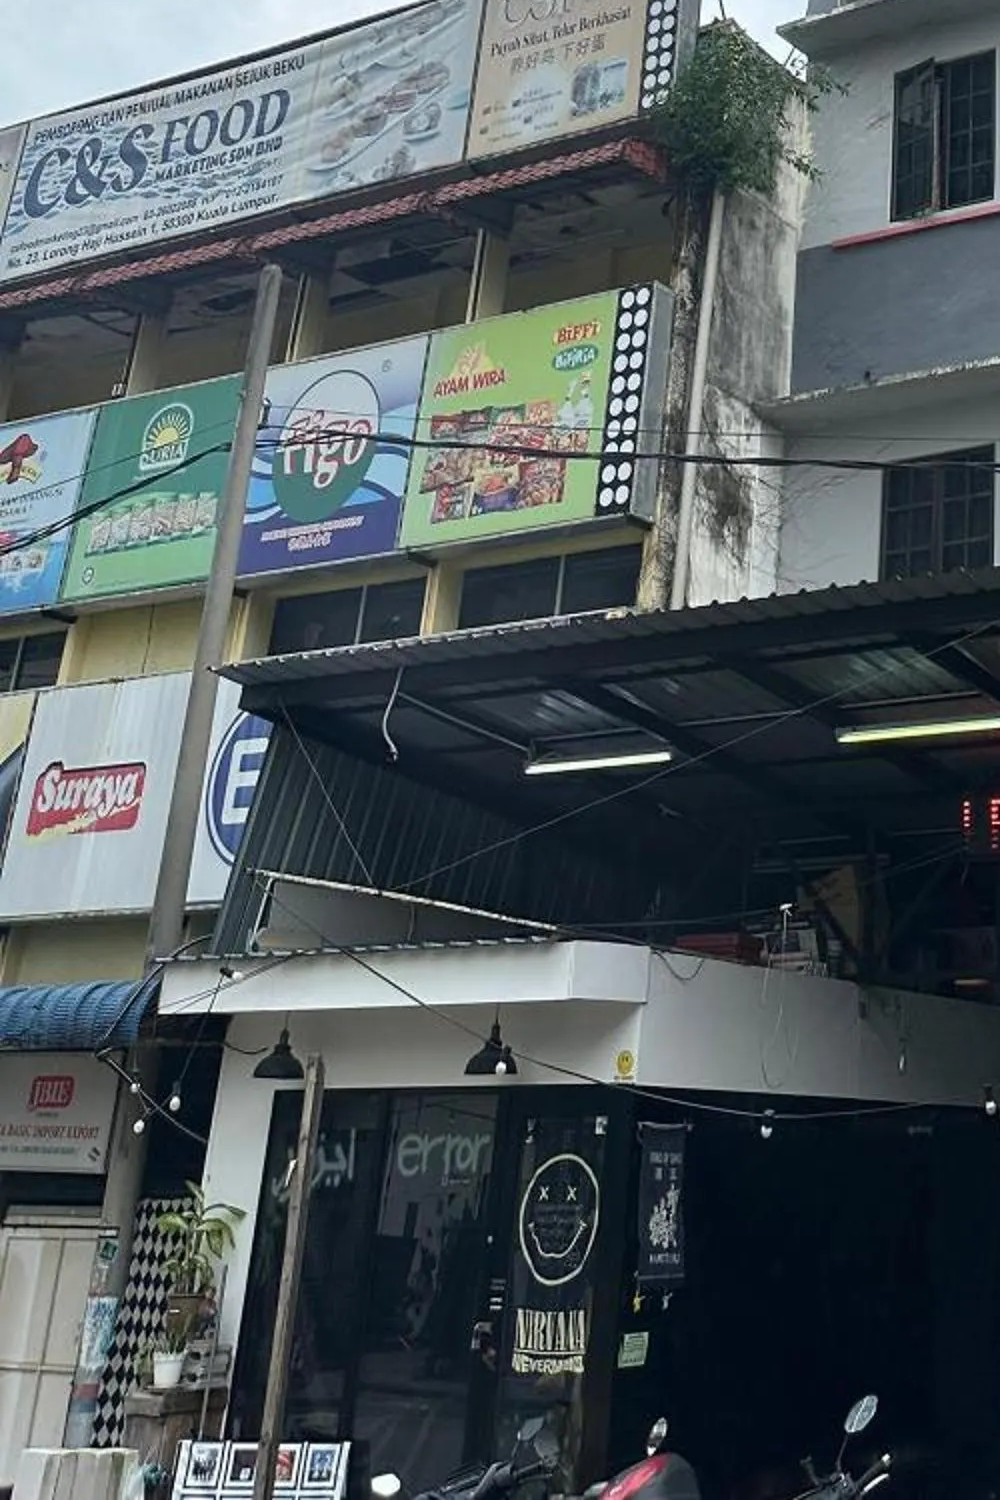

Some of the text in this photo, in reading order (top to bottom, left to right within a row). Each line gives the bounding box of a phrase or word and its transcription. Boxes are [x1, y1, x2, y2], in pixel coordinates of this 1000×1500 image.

[174, 74, 233, 105] MAKANAN
[273, 54, 306, 78] BEKU
[23, 87, 292, 220] C&S FOOD
[154, 150, 230, 182] MARKETING
[433, 376, 470, 399] AYAM
[397, 1131, 491, 1178] error
[514, 1308, 585, 1351] NIRVANA
